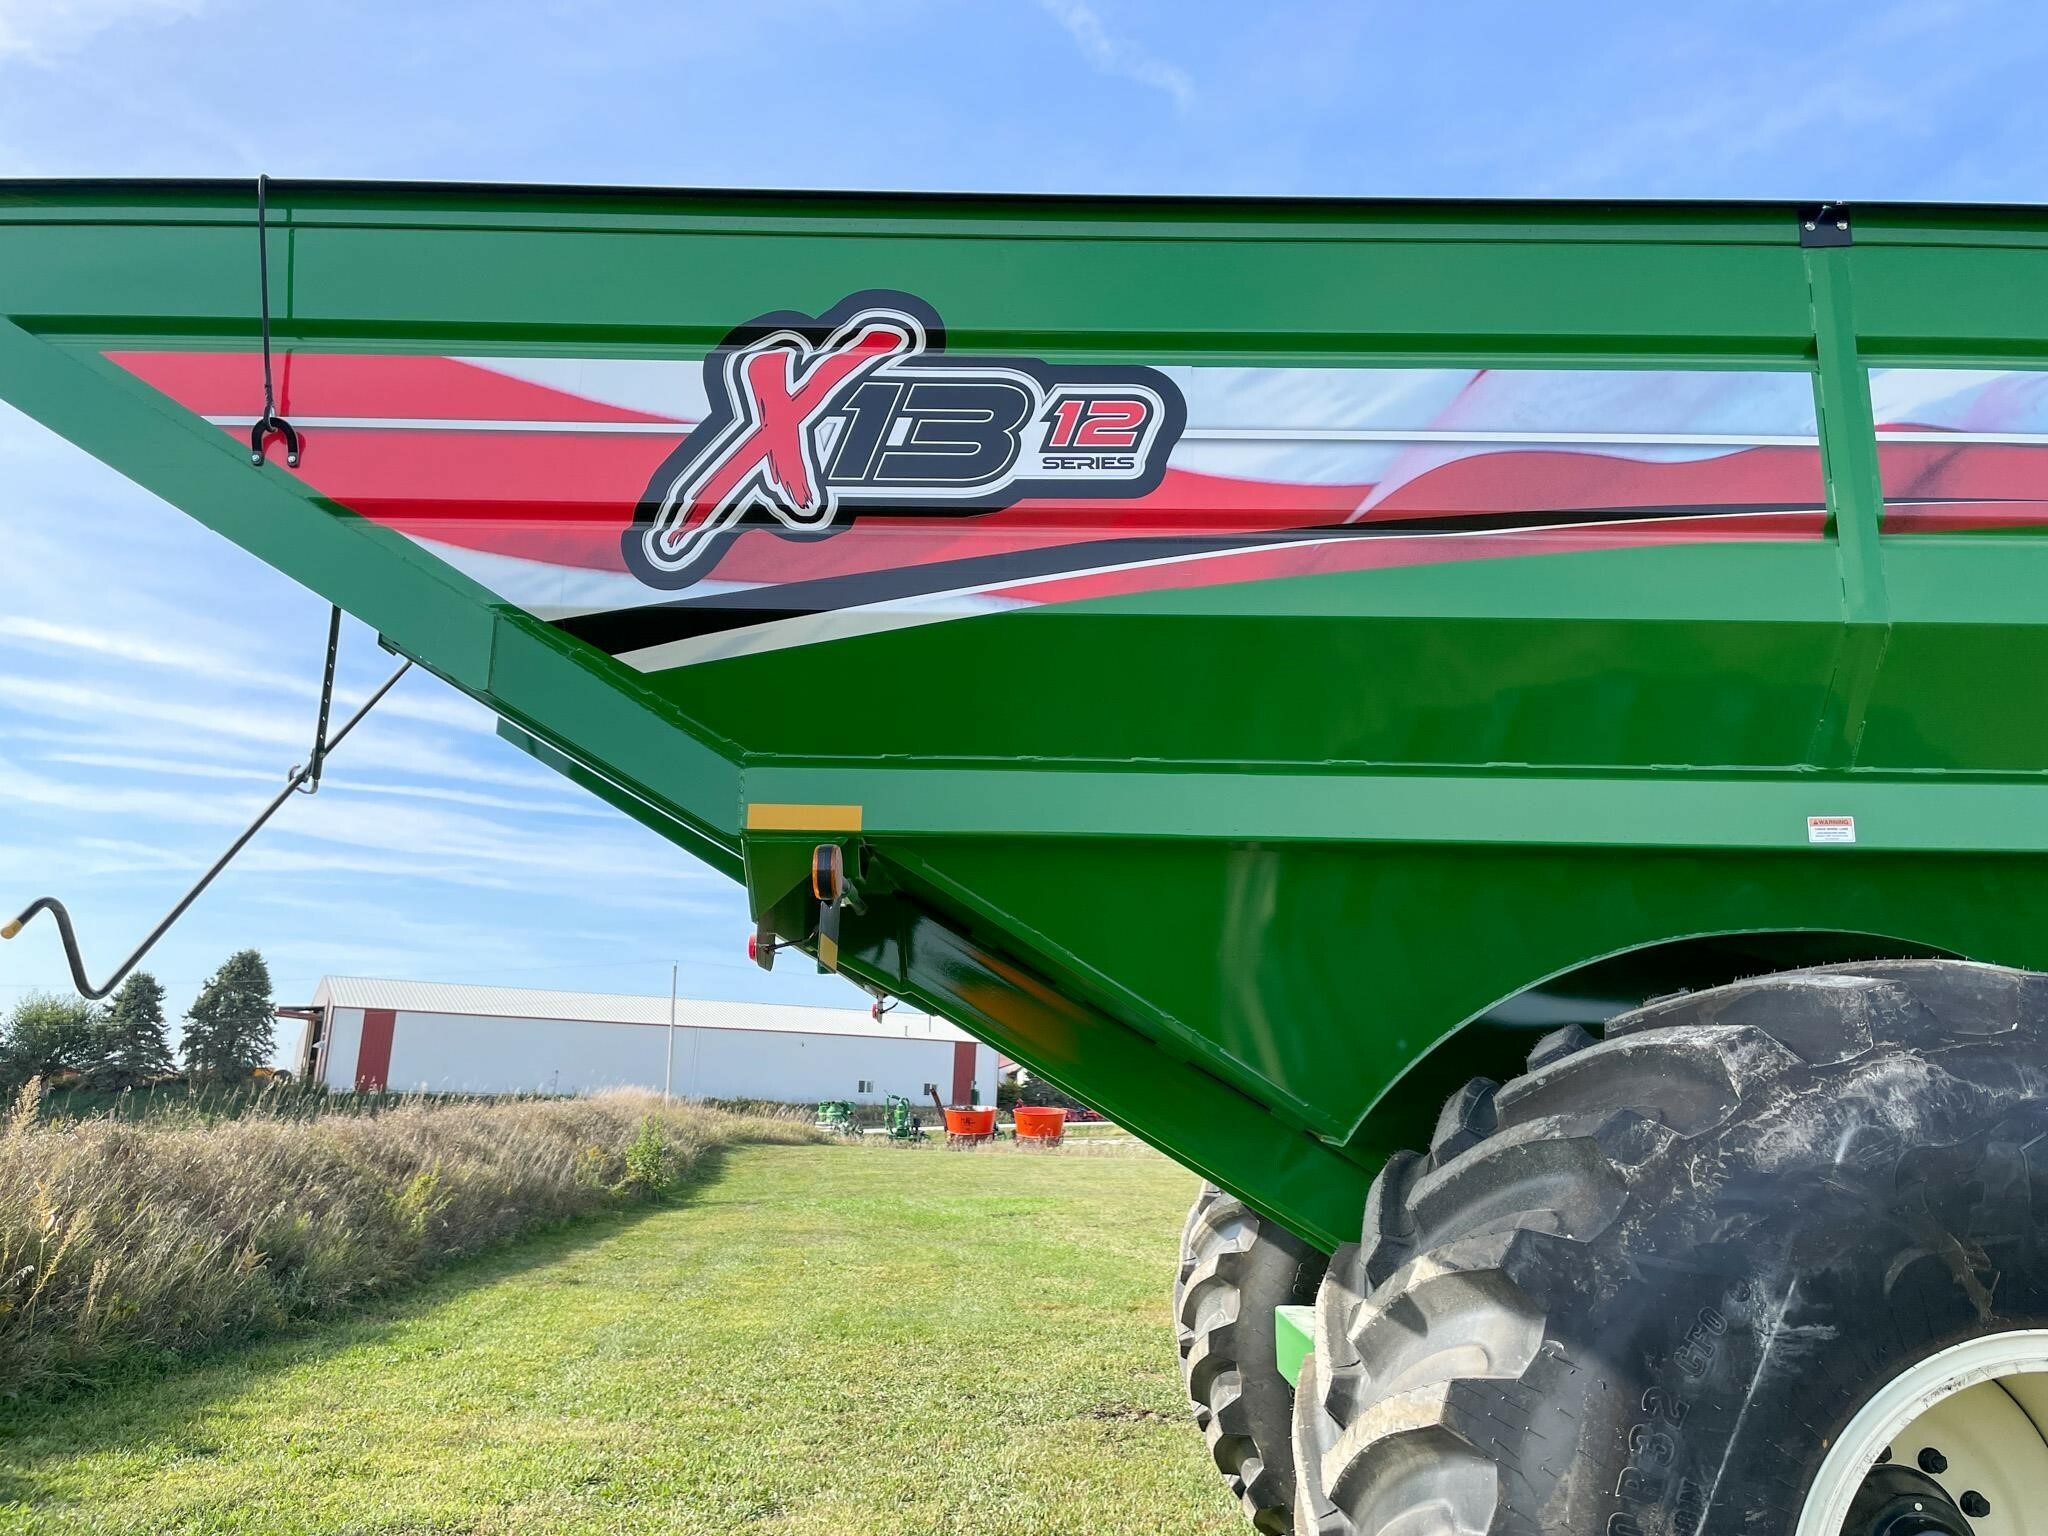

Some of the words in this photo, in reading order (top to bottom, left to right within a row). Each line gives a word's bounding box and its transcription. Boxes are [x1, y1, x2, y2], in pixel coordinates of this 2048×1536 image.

[667, 331, 1029, 548] X13
[1048, 400, 1147, 447] 12
[1042, 456, 1135, 470] SERIES
